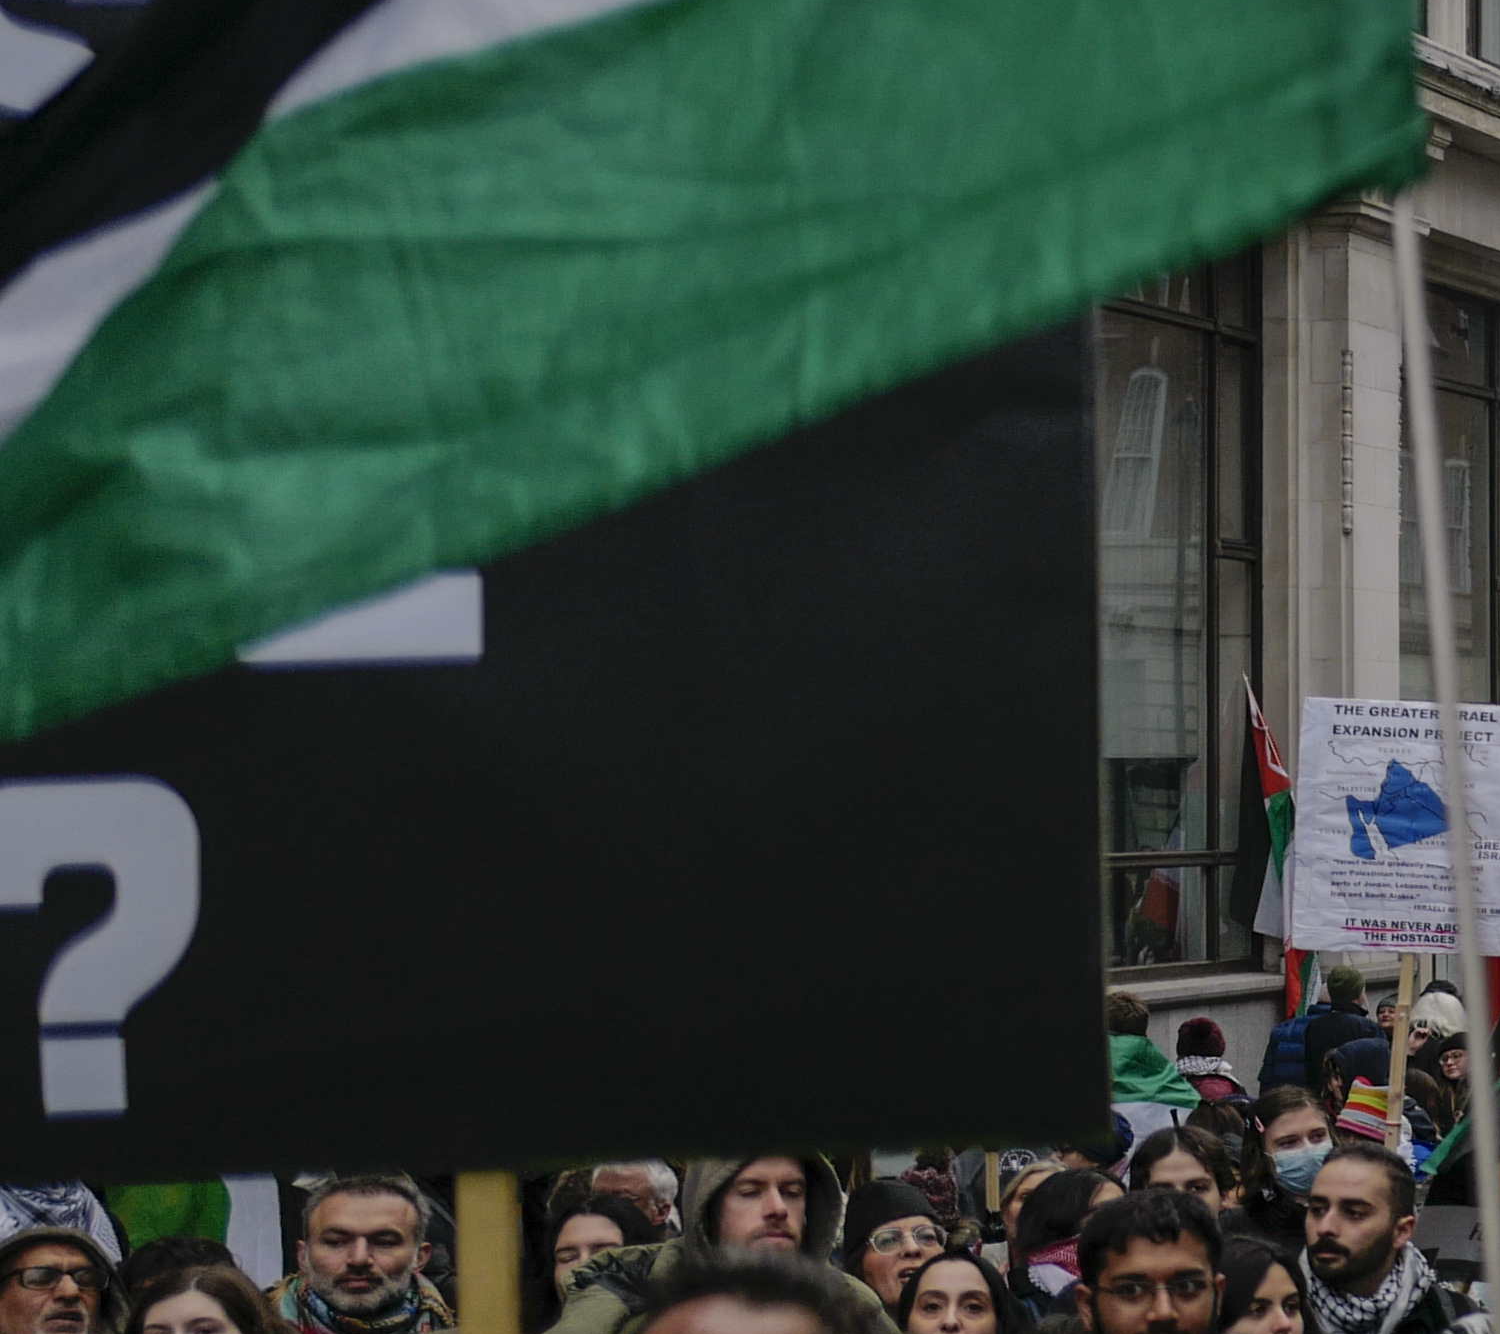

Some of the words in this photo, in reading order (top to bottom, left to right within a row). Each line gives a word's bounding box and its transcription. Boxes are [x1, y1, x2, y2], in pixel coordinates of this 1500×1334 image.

[1334, 704, 1364, 717] THE
[1369, 706, 1440, 720] GREATER
[1333, 725, 1419, 740] EXPANSION
[1425, 729, 1494, 743] PRJECT
[1345, 918, 1357, 926] IT
[1360, 918, 1387, 928] WAS
[1391, 919, 1431, 931] NEVER
[1436, 923, 1460, 932] ABO
[1364, 932, 1388, 941] THE
[1391, 932, 1456, 944] HOSTAGES
